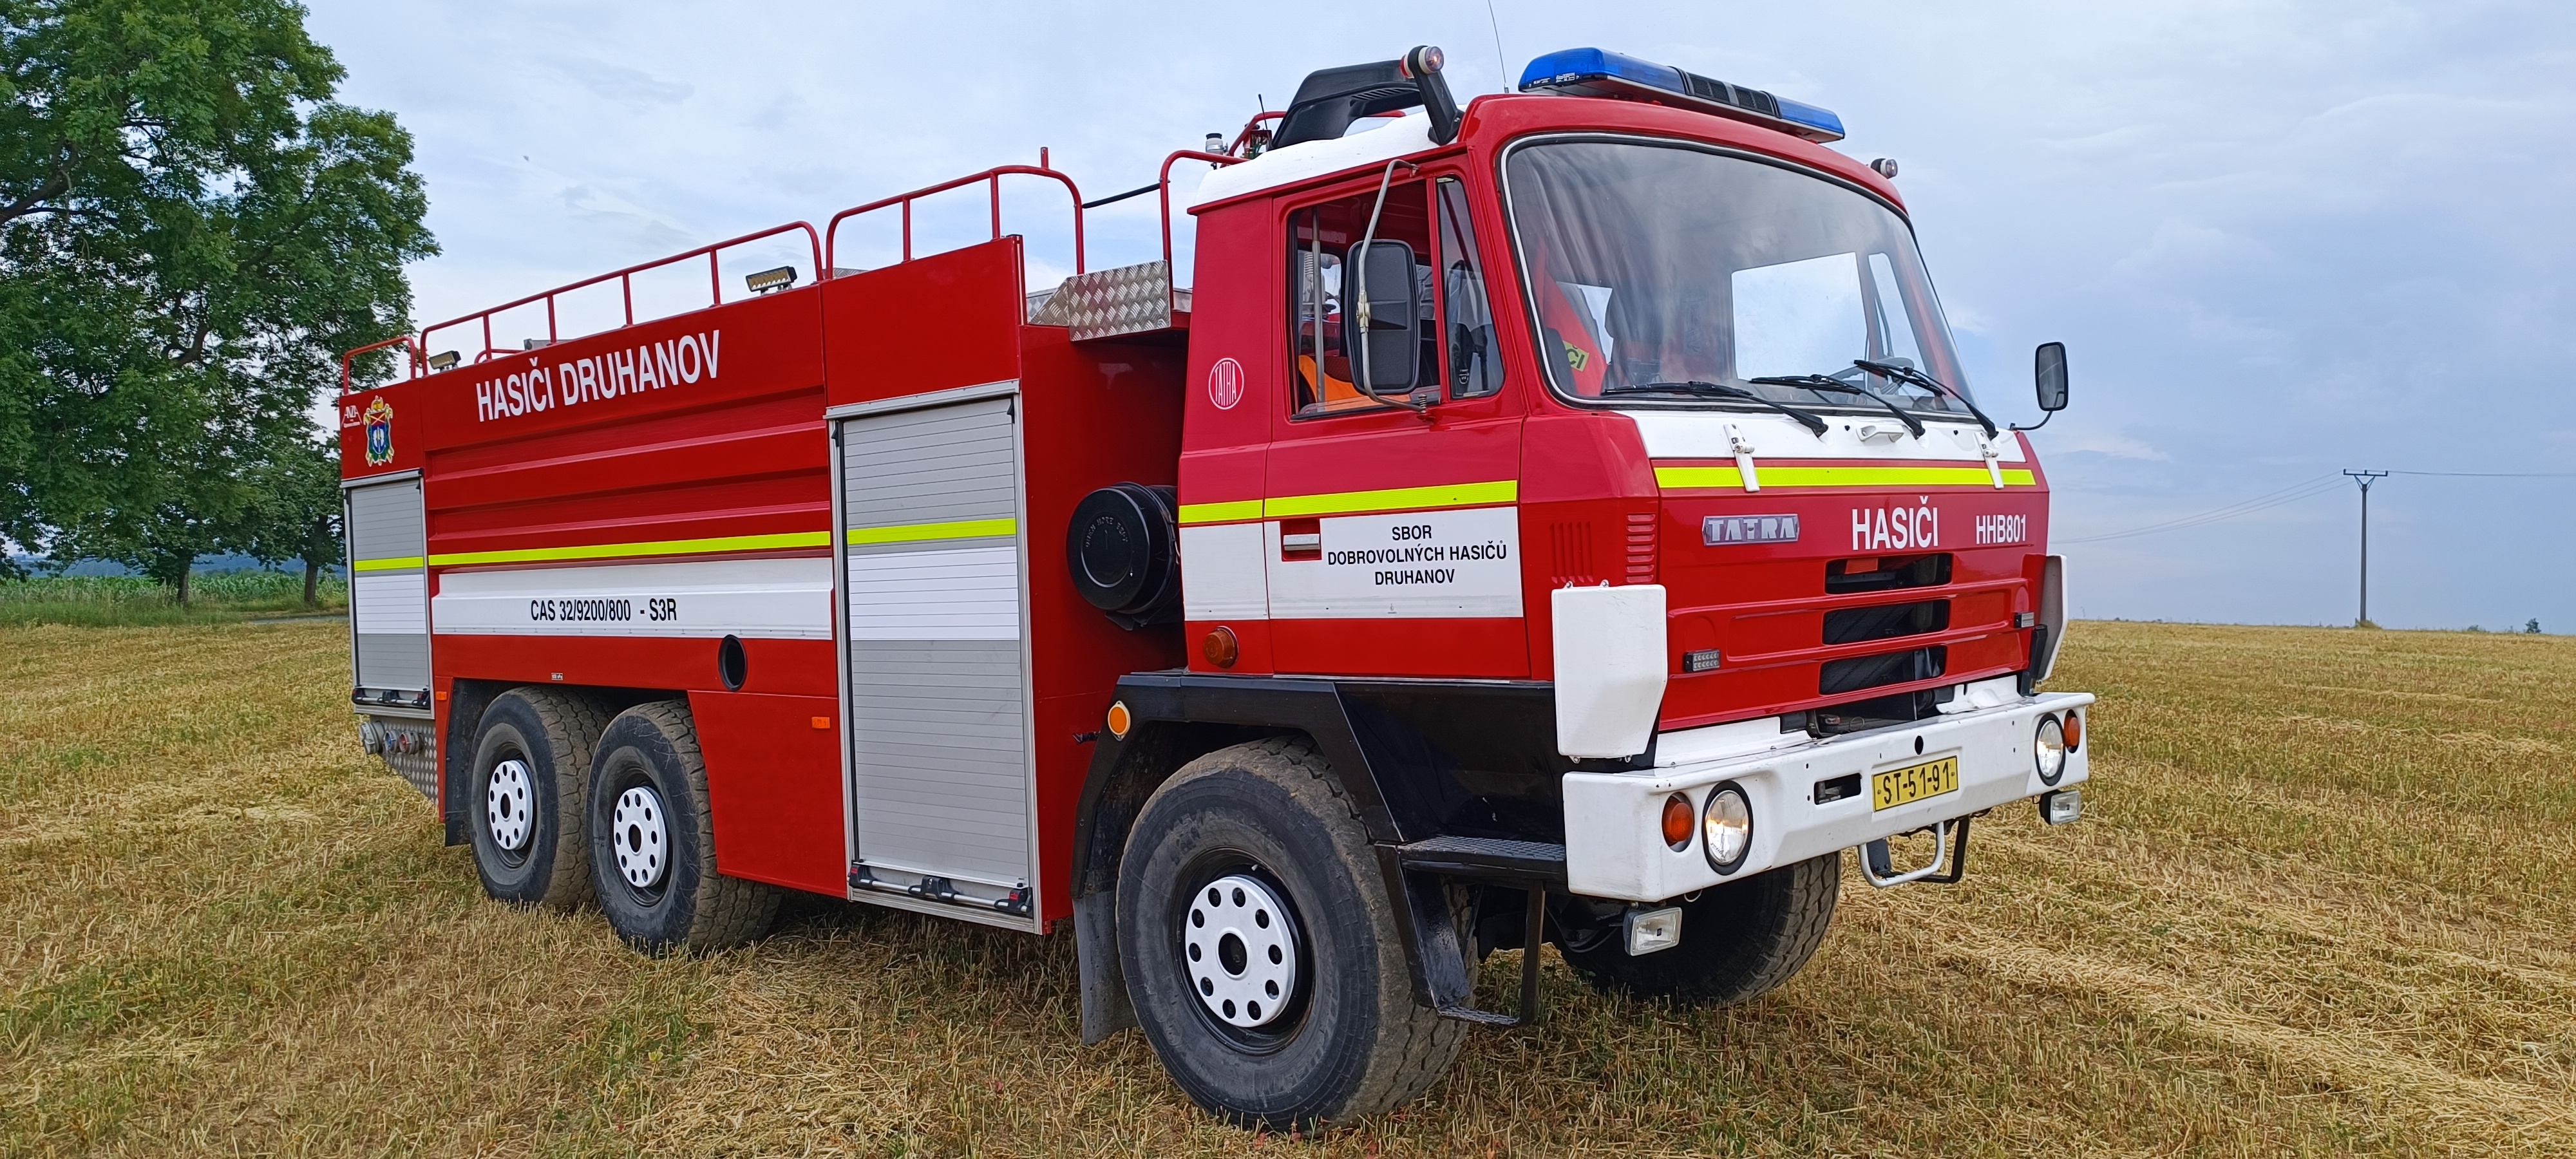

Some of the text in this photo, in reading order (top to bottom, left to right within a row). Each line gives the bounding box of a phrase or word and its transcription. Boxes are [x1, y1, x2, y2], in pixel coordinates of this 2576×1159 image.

[477, 330, 720, 422] HASIČI DRUHANOV
[1392, 525, 1432, 541] SBOR
[1709, 517, 1796, 542] TATRA
[1852, 495, 1938, 551] HASIČI
[1976, 514, 2026, 544] HHB801
[1328, 540, 1506, 565] DOBROVOLNÝCH HASIČŮ
[1375, 569, 1455, 585] DRUHANOV
[531, 599, 556, 621] CAS
[559, 598, 631, 621] 32/9200/800
[649, 598, 677, 621] S3R
[1883, 761, 1949, 804] ST-51-91
